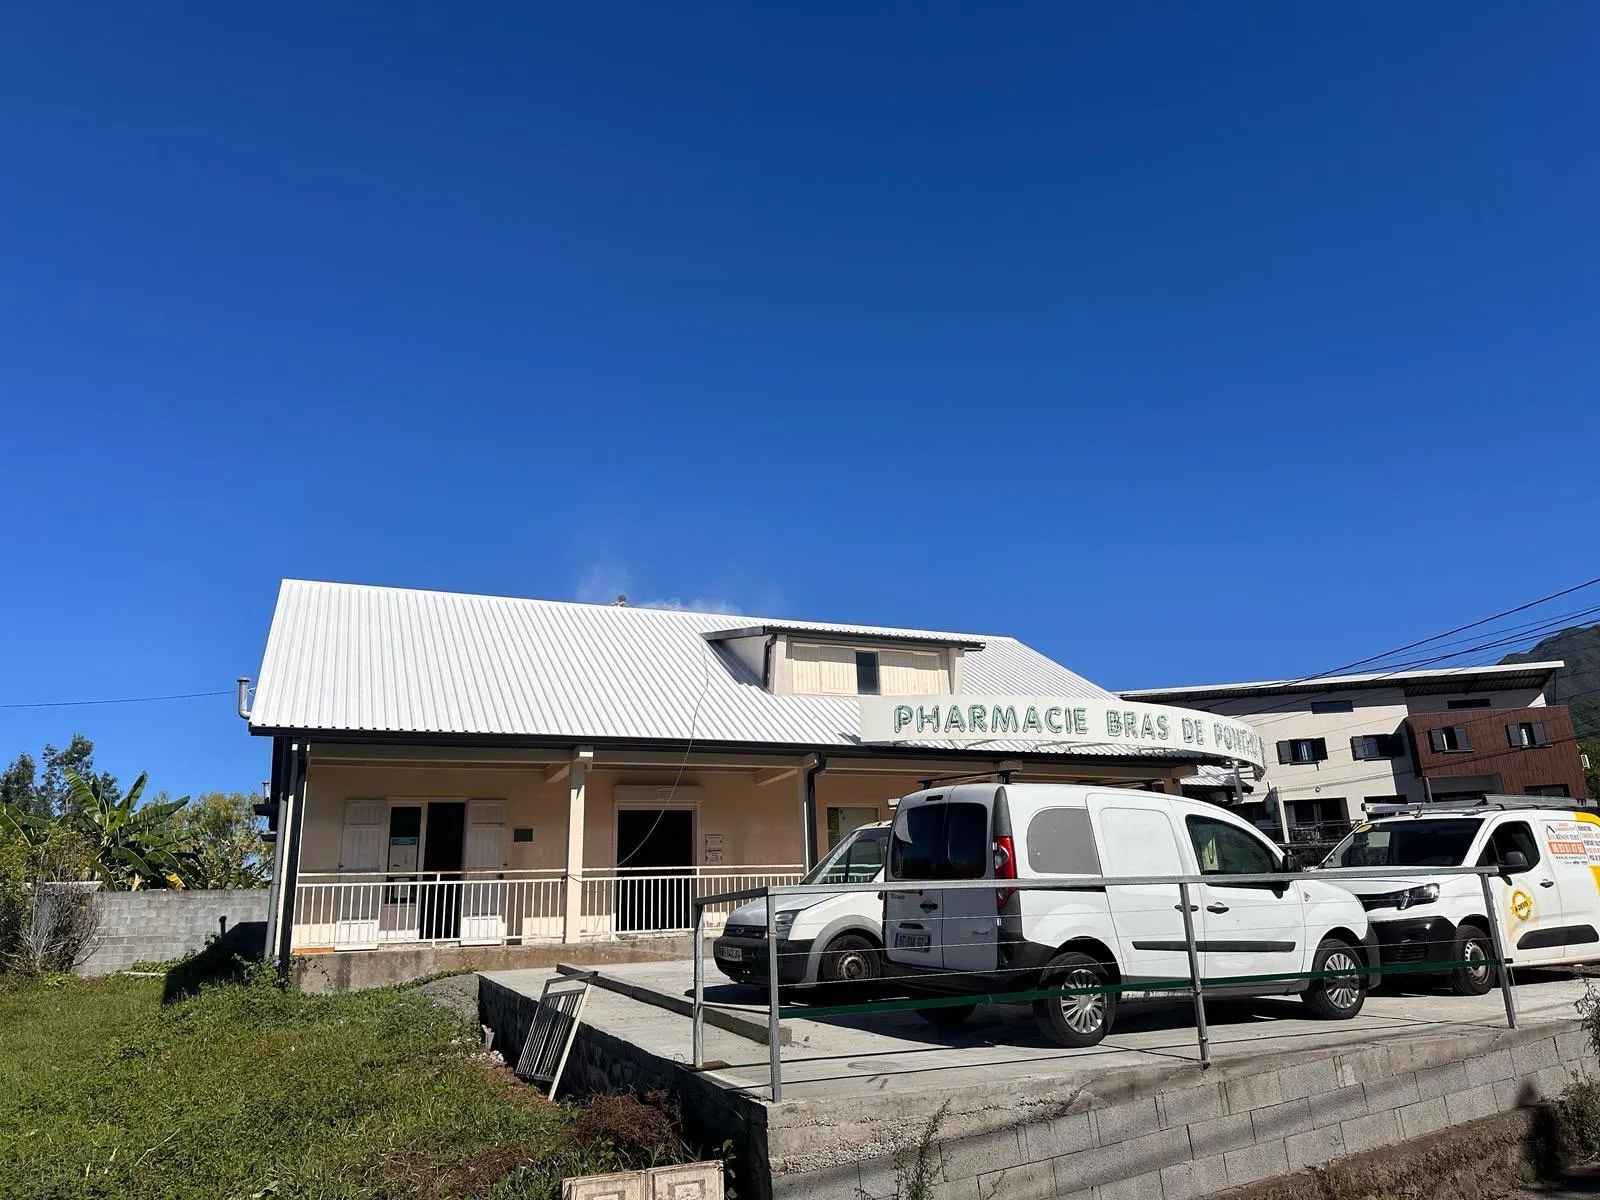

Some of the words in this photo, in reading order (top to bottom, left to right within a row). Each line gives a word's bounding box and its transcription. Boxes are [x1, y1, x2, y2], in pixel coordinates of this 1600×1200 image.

[894, 705, 1088, 735] PHARMACIE
[1106, 710, 1170, 740] BRAS
[1182, 717, 1205, 746] DE
